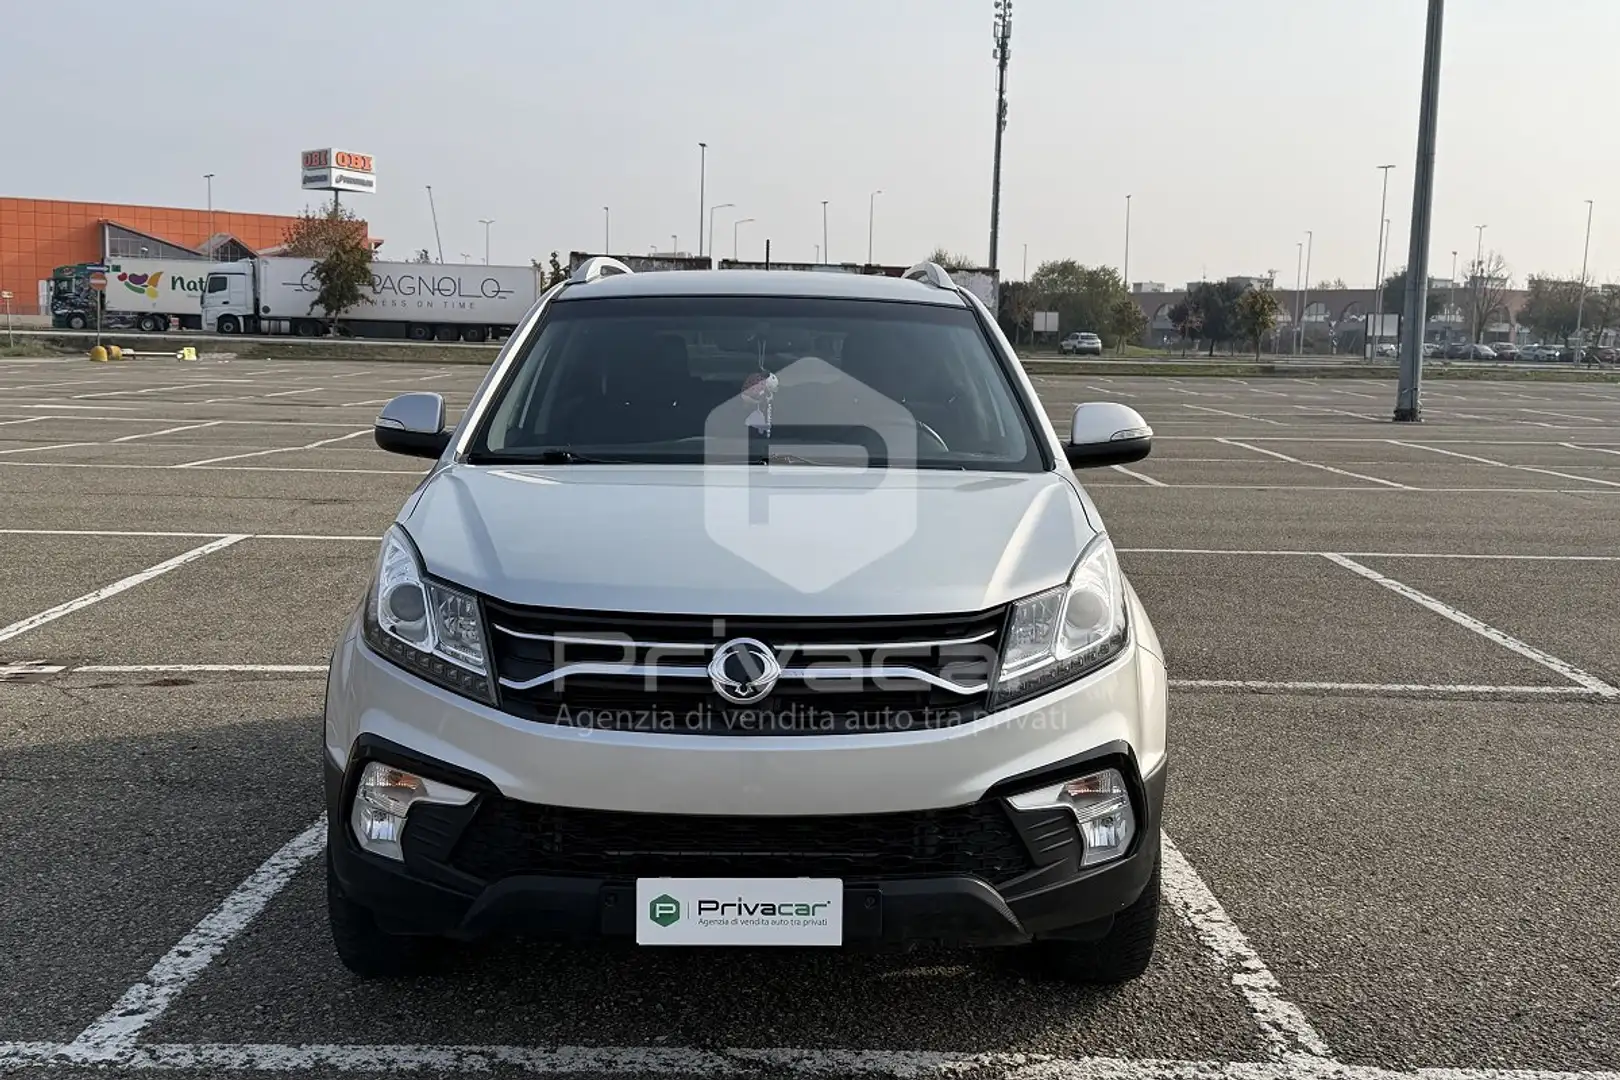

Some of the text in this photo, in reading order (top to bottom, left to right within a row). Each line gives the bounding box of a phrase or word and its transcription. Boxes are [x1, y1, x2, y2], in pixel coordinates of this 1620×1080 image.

[303, 150, 328, 168] OBI
[335, 151, 373, 171] OBI
[300, 270, 502, 300] CPAGNOLO
[416, 299, 434, 309] ON
[443, 300, 475, 310] TIME
[697, 918, 729, 927] Agenzia
[731, 918, 738, 926] di
[740, 918, 770, 926] vendita
[803, 918, 828, 927] privati
